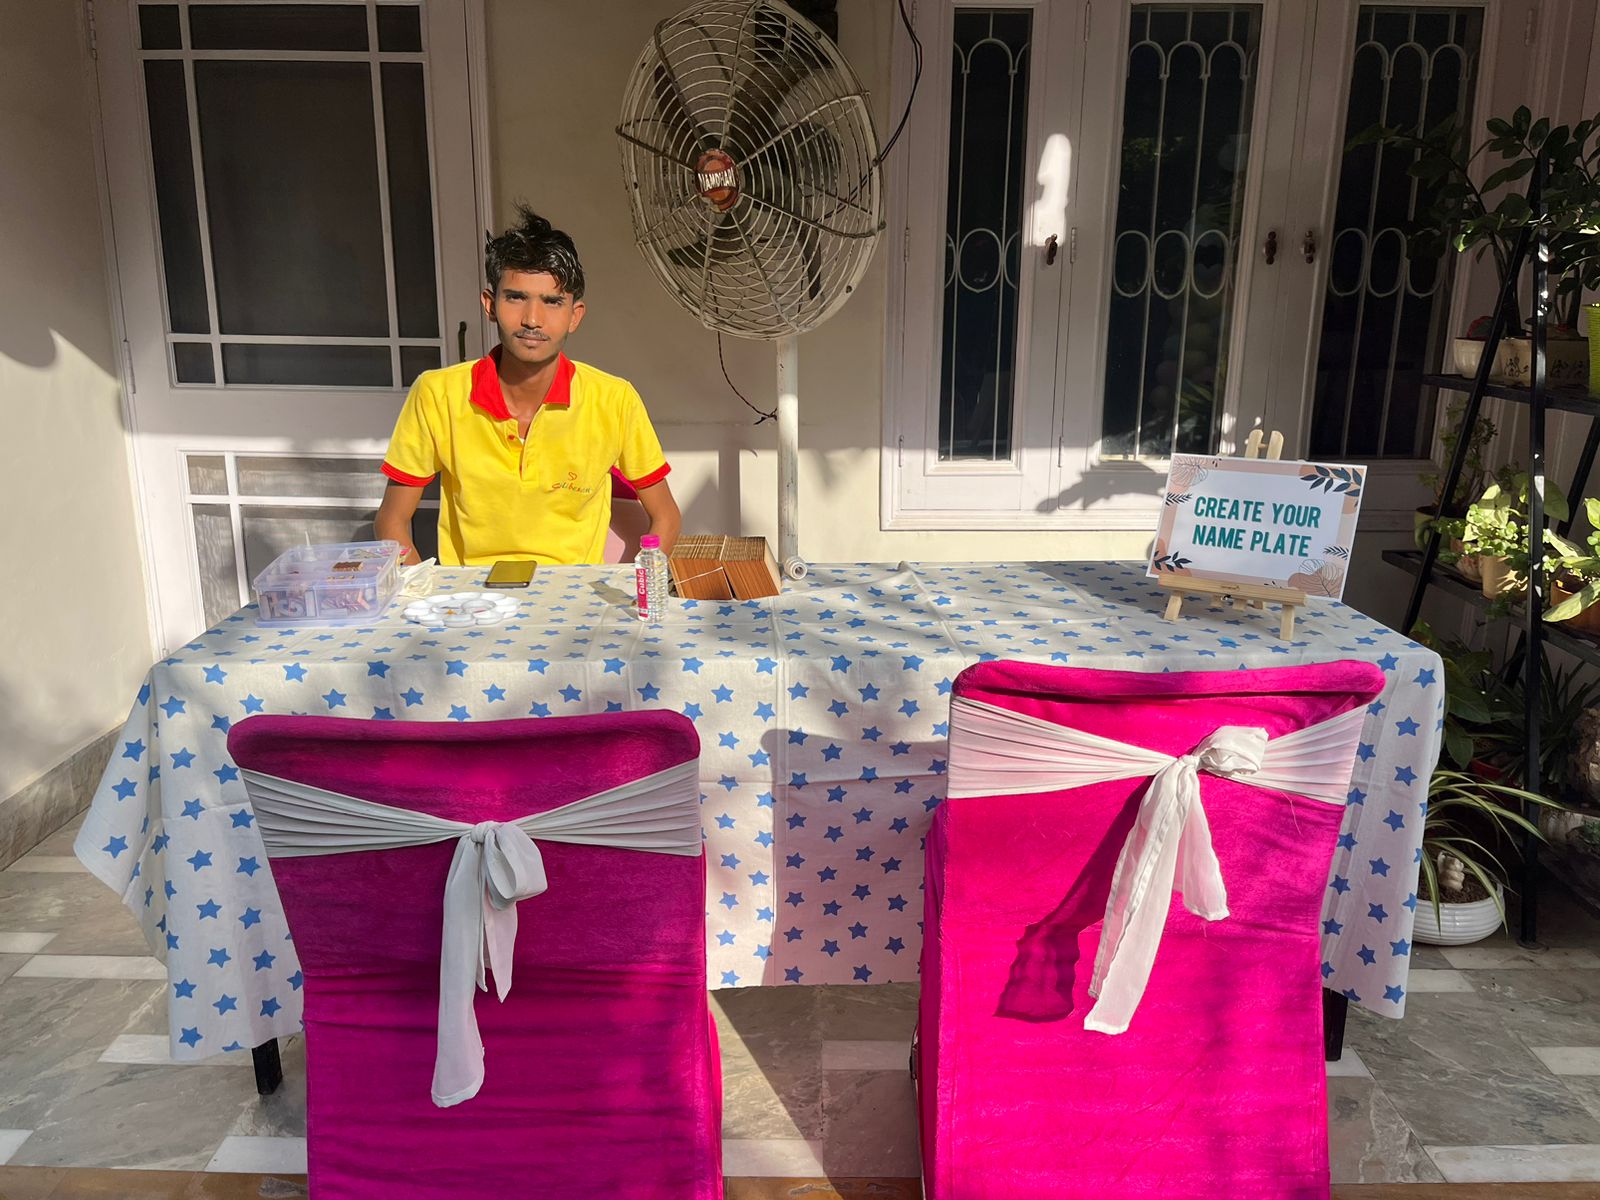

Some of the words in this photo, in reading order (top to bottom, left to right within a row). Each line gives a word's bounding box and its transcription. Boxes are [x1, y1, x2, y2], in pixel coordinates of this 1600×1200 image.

[1194, 496, 1265, 523] CREATE
[1272, 502, 1322, 529] YOUR
[1192, 524, 1246, 550] NAME
[1250, 531, 1312, 557] PLATE
[638, 569, 646, 595] Cubic
